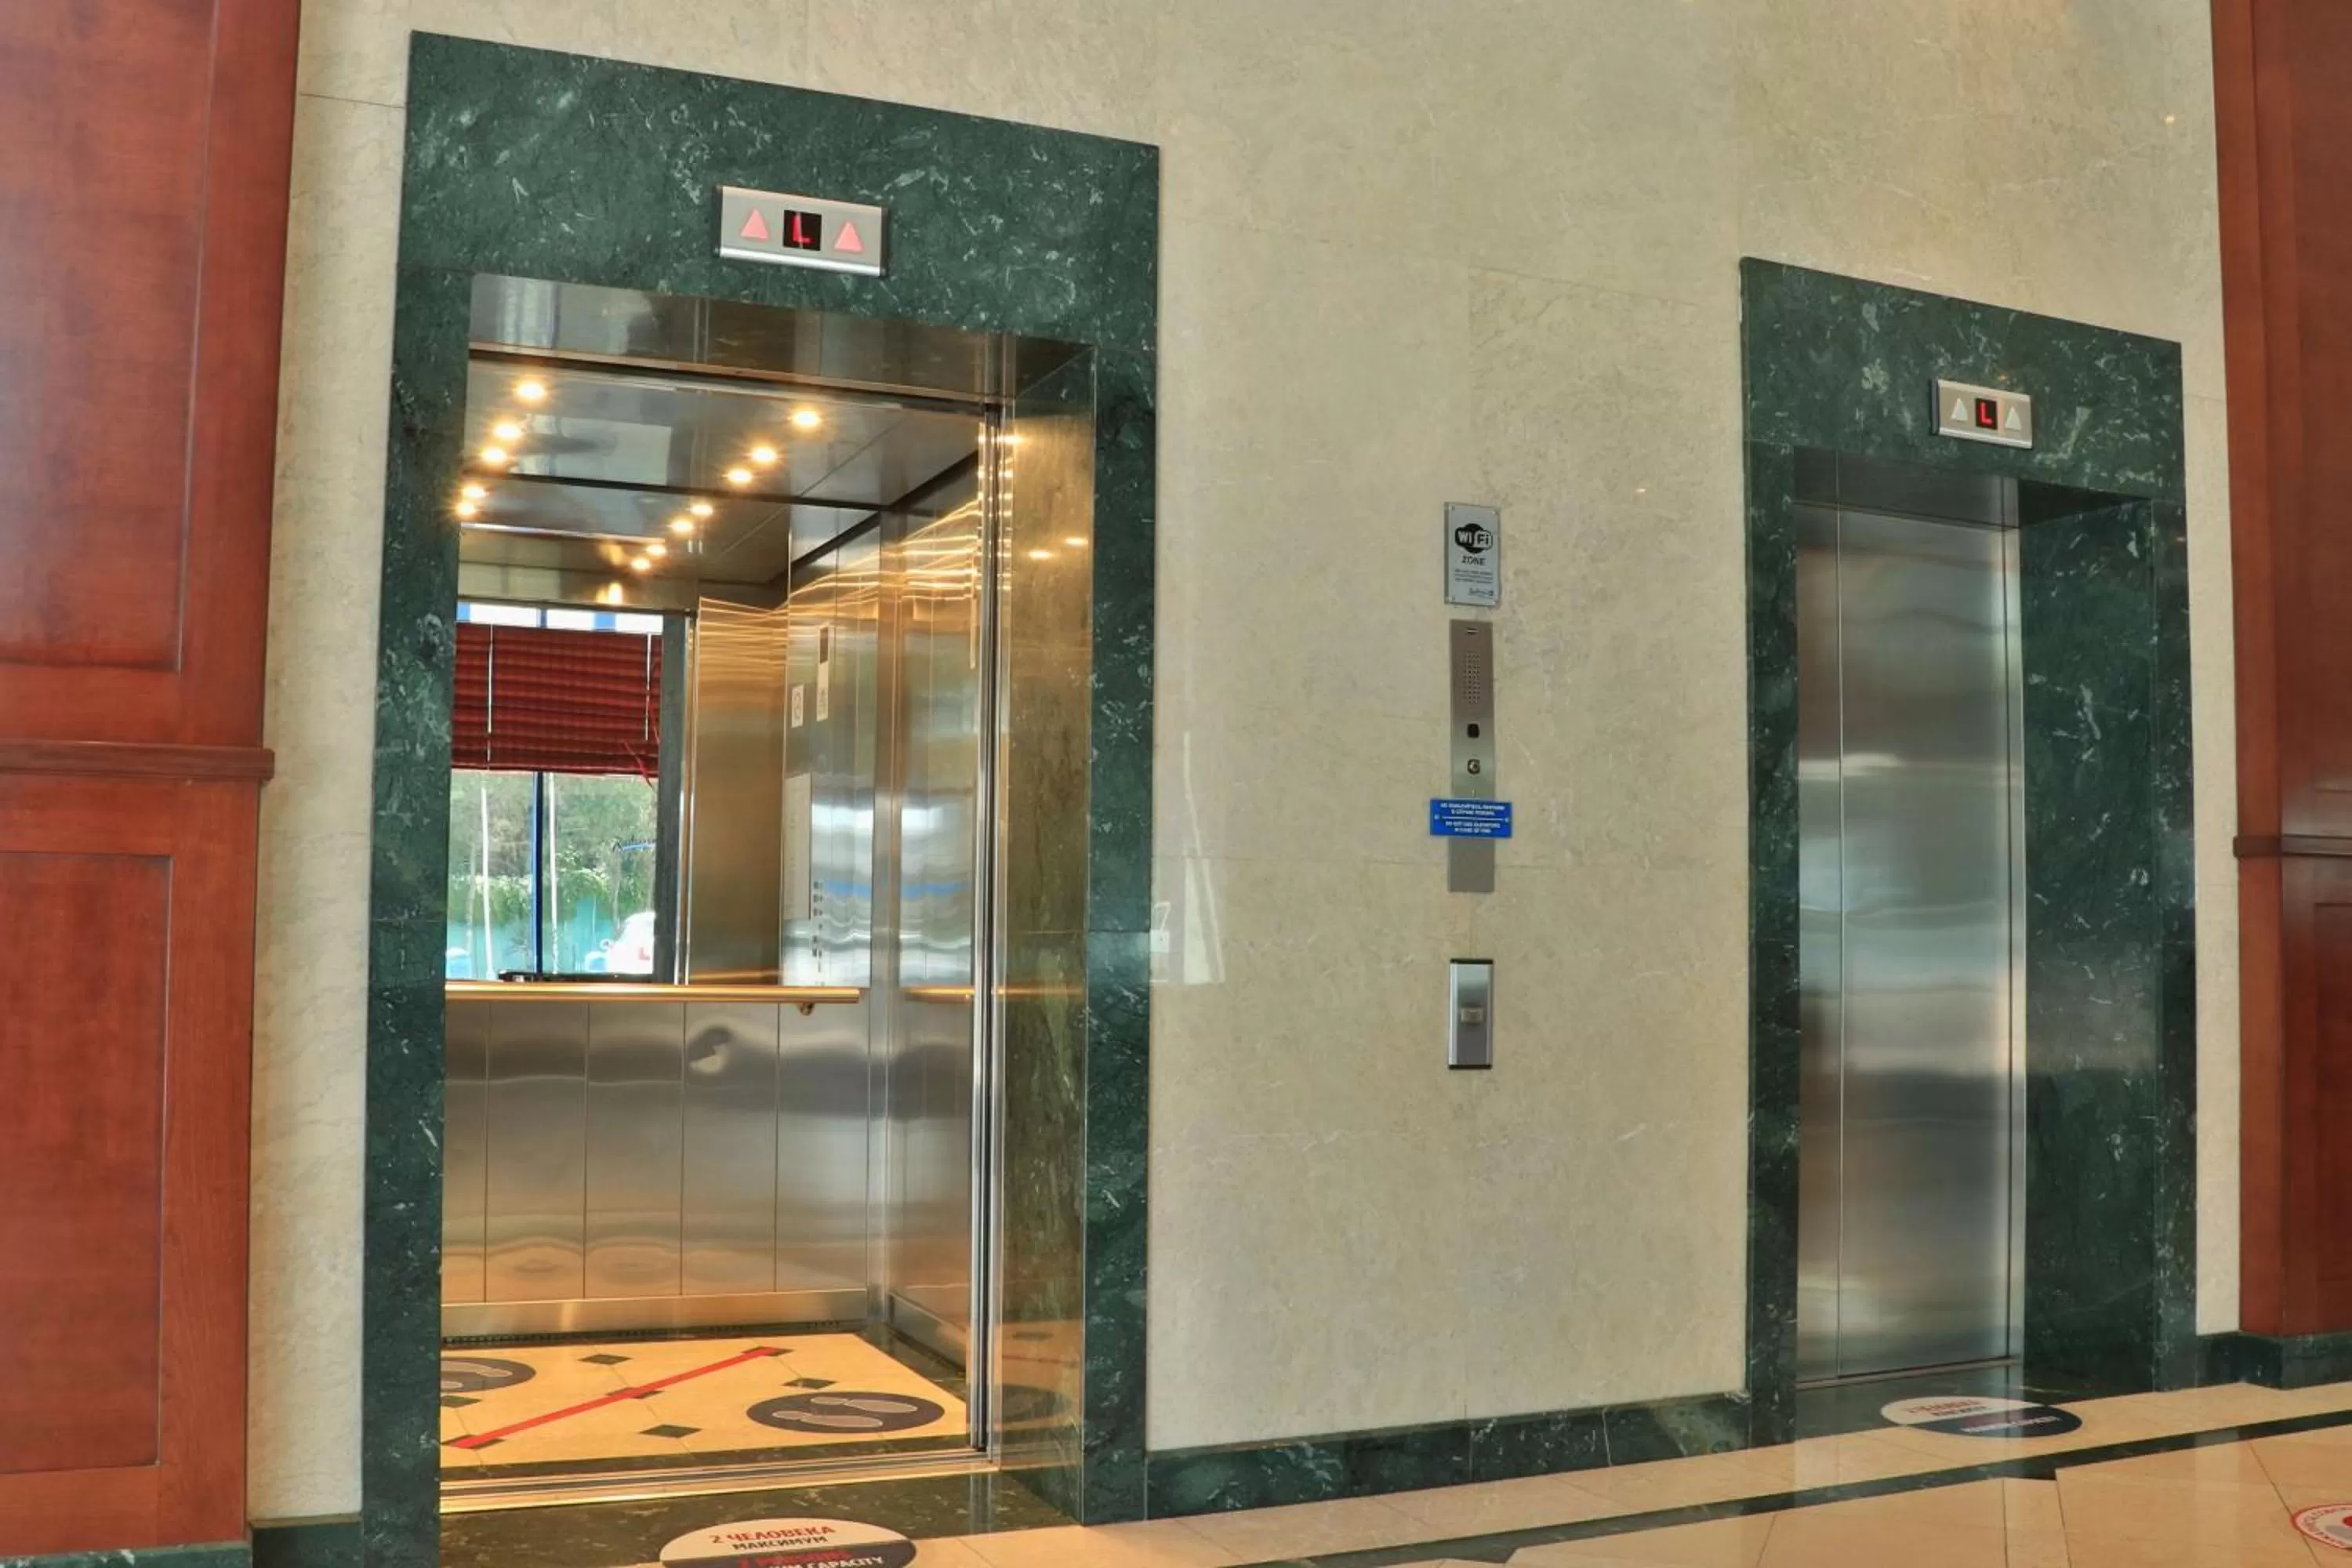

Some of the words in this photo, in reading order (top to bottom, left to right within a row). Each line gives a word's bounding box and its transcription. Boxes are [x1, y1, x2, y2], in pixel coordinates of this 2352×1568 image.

[793, 211, 812, 244] L
[1980, 401, 1994, 425] L
[1461, 555, 1486, 565] ZONE
[709, 1534, 724, 1544] 2
[727, 1526, 836, 1541] ЧЕЛОВЕКА
[732, 1536, 828, 1550] МАКСИМУМ
